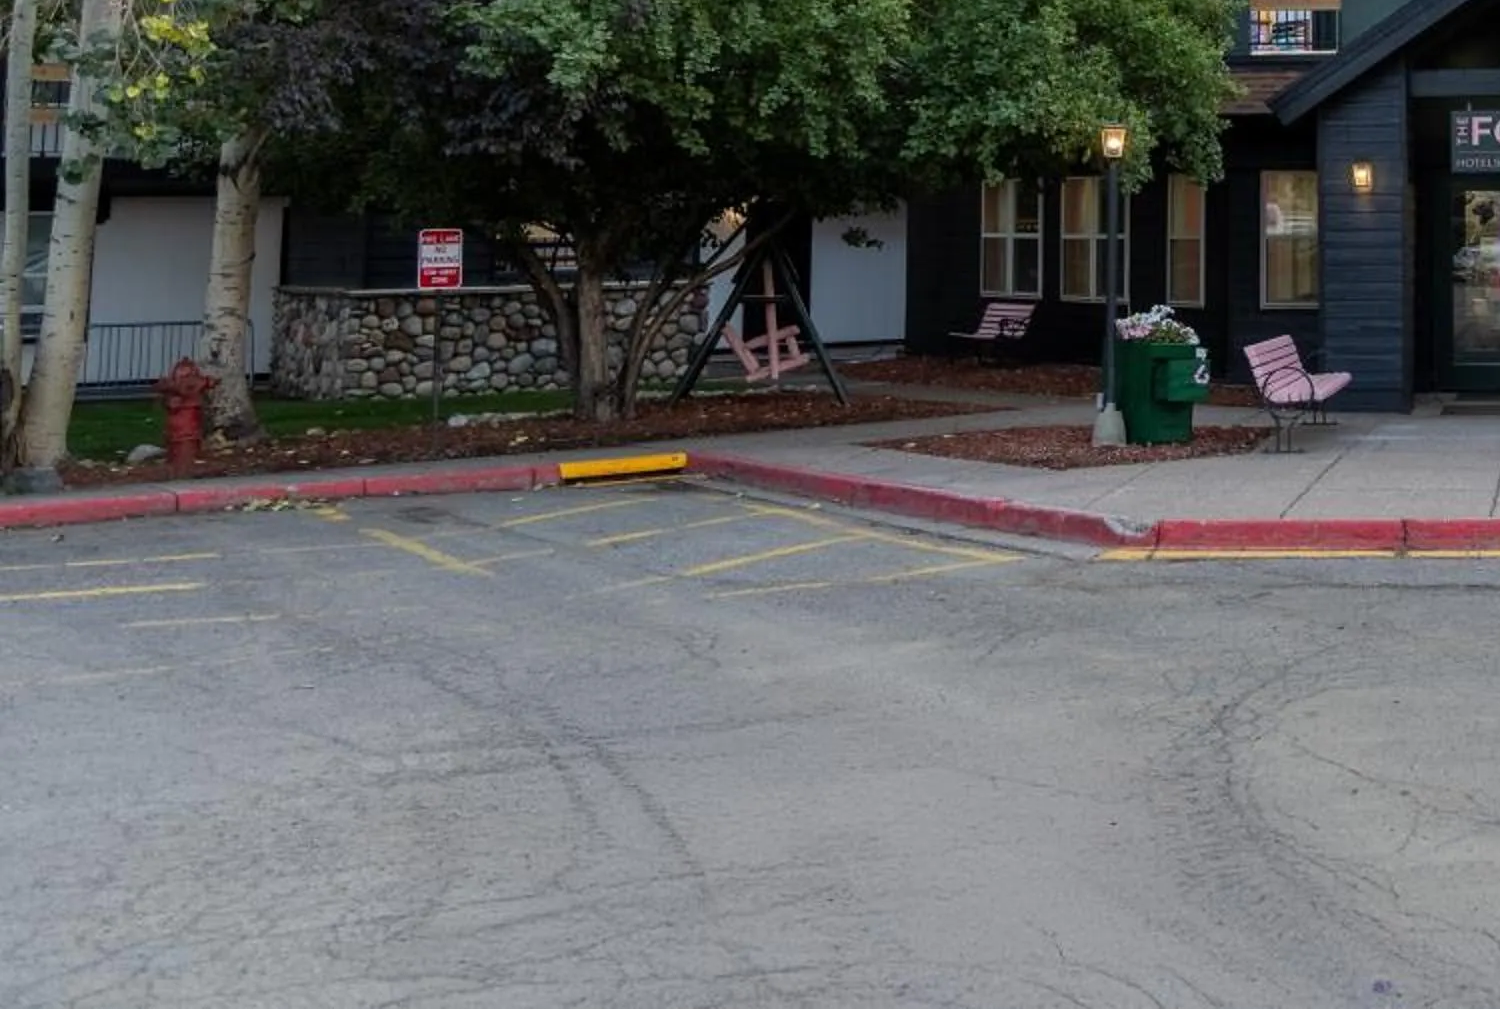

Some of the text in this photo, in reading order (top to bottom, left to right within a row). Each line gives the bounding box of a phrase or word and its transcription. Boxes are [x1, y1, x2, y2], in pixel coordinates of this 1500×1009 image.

[1456, 116, 1469, 145] THE
[1456, 158, 1500, 168] HOTELS
[421, 256, 459, 264] PARKING
